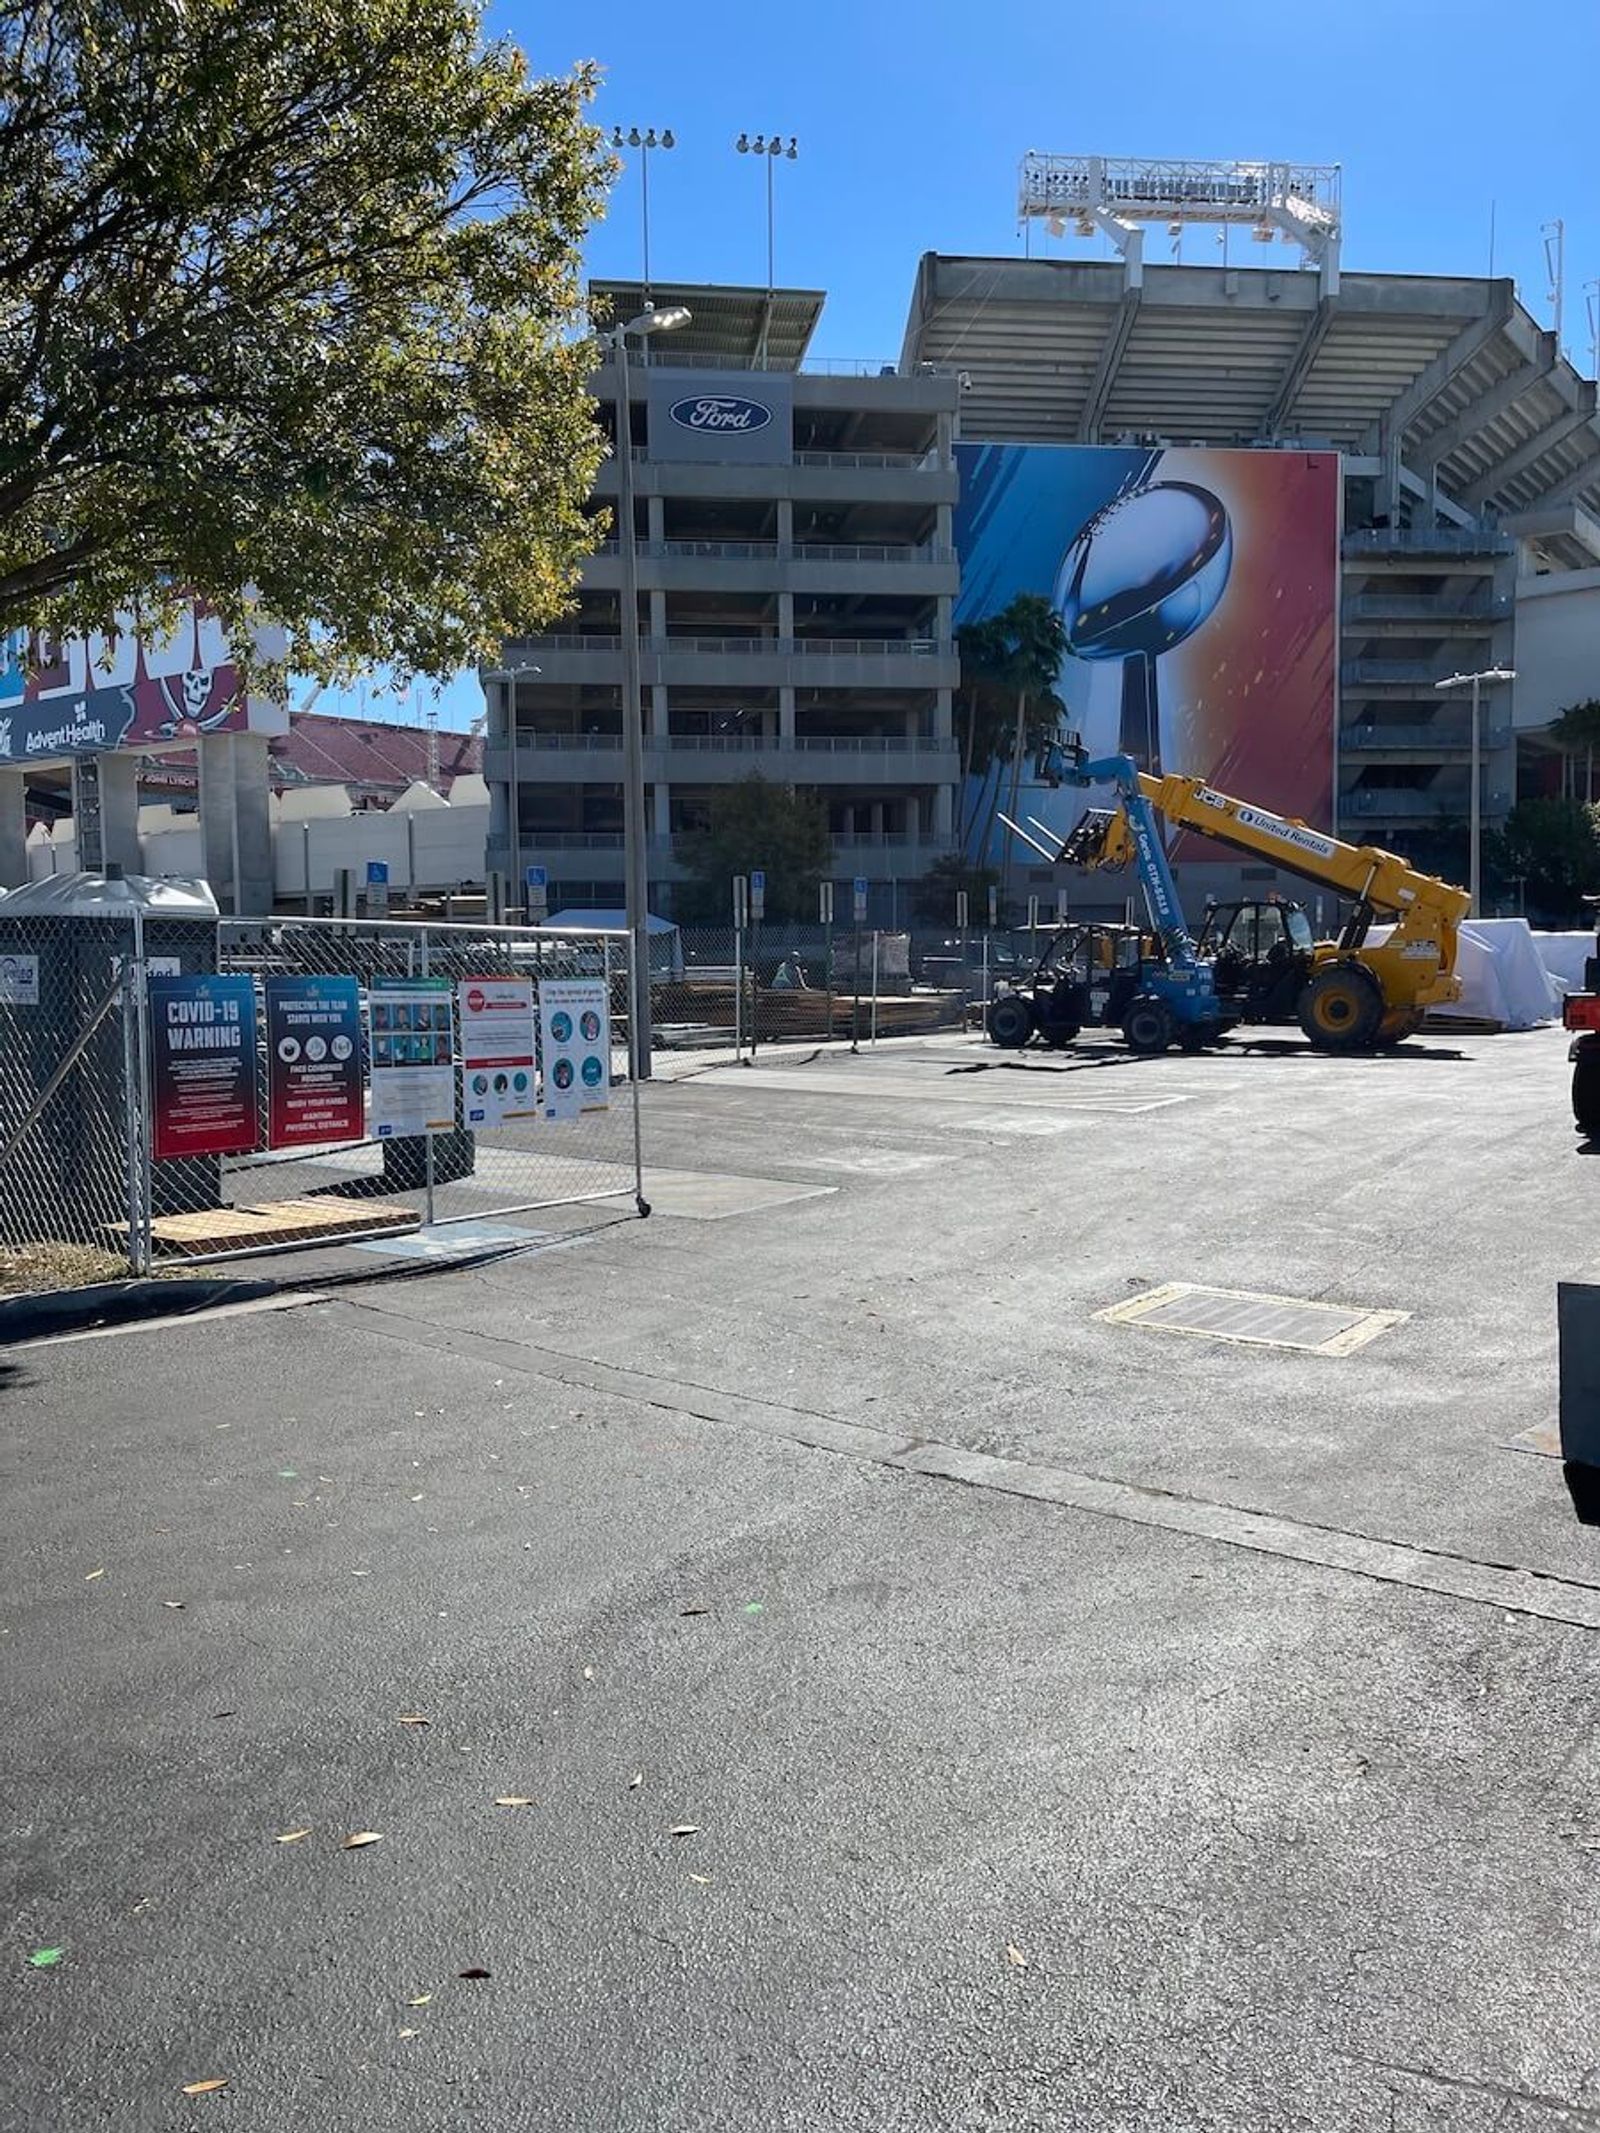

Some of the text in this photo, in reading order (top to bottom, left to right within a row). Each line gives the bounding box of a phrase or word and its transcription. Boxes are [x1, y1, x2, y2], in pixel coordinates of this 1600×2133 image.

[689, 400, 752, 427] Ford
[25, 719, 106, 753] AdventHealth
[145, 774, 169, 784] JOHN
[169, 776, 197, 788] LYNCH
[1193, 787, 1226, 809] JCB
[1253, 815, 1330, 857] United Rentals
[167, 1000, 240, 1024] COVID-19
[279, 1000, 318, 1011] PROTECTING
[167, 1026, 242, 1050] WARNING
